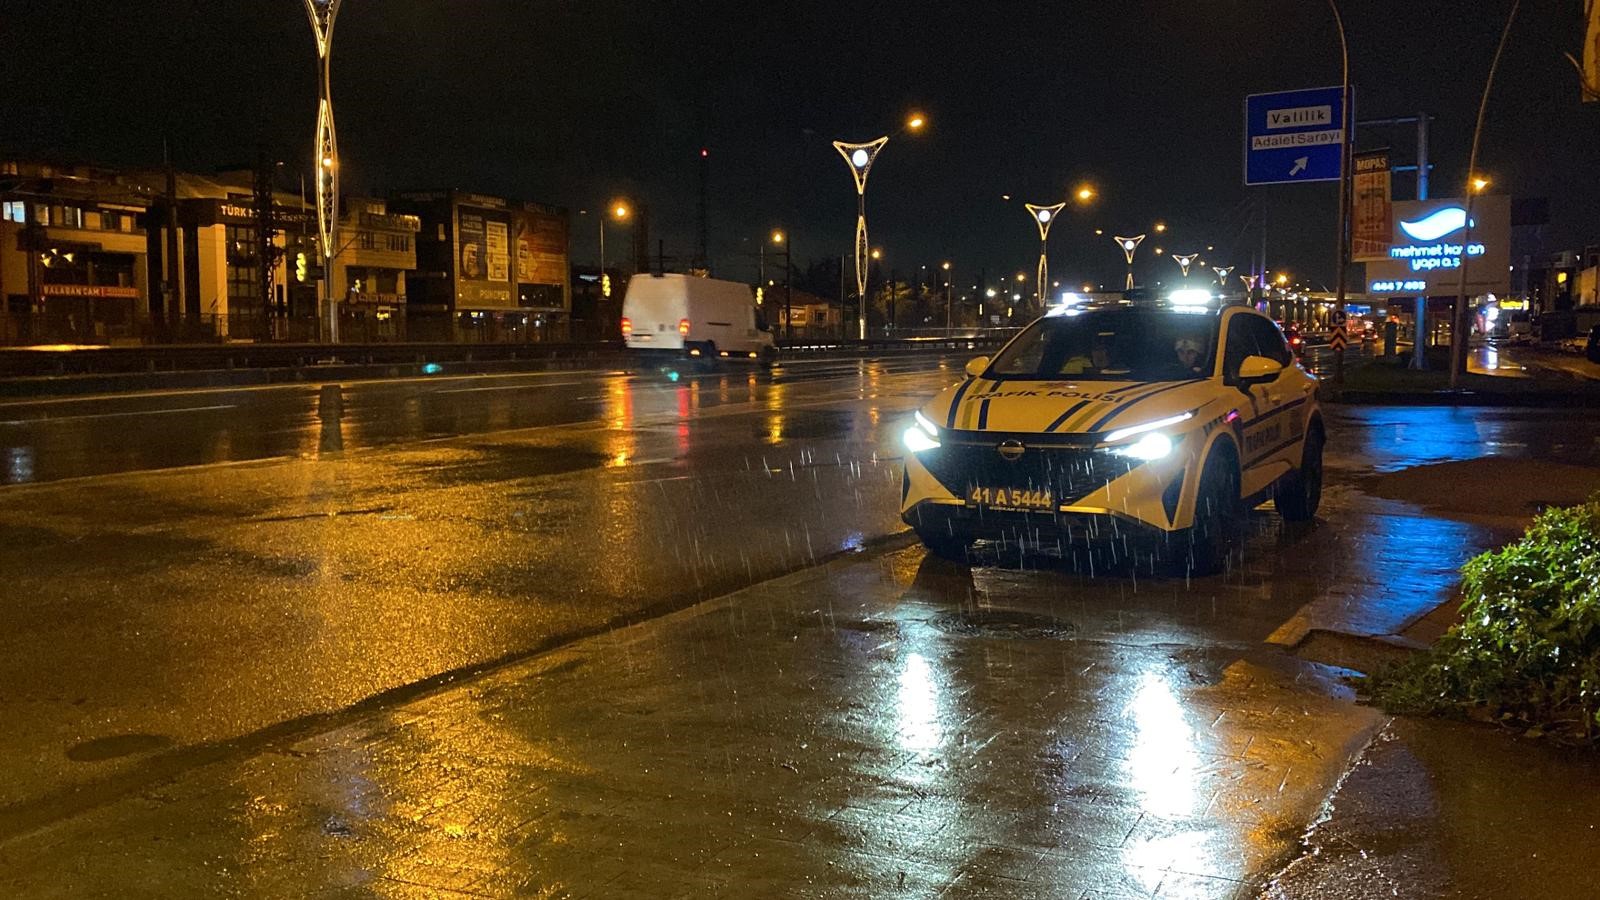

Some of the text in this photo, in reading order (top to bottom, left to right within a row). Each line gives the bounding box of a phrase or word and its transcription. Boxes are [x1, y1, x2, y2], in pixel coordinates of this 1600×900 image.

[1271, 109, 1325, 124] Valilik
[221, 203, 247, 217] TÜRK
[1391, 244, 1443, 257] mehmet
[1443, 243, 1485, 256] kaan
[972, 487, 1052, 508] 41 A 5444
